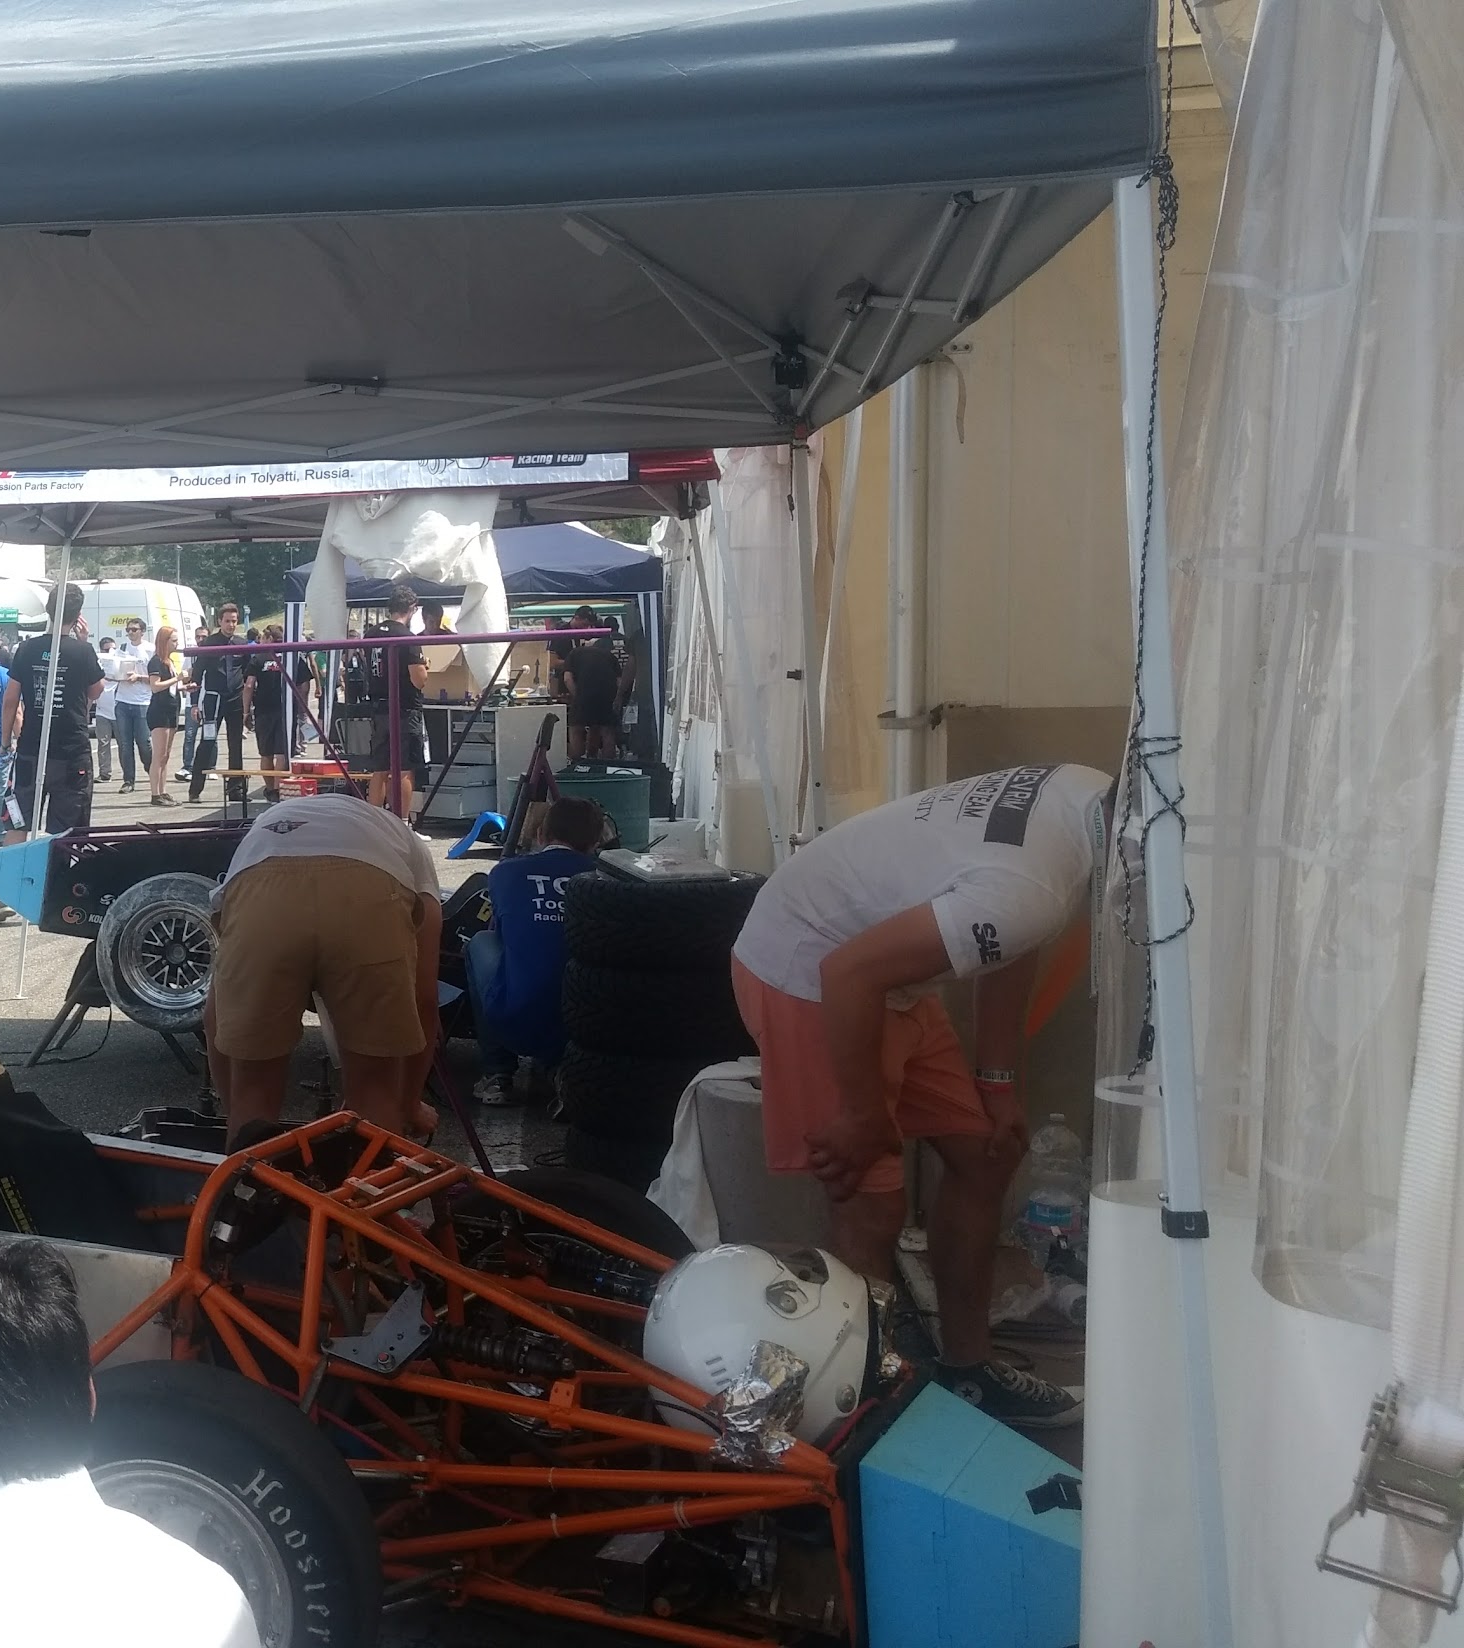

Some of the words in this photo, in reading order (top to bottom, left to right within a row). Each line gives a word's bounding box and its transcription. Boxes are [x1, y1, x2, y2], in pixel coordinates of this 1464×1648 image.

[517, 453, 554, 466] Racing
[556, 453, 584, 464] Team
[24, 482, 48, 491] Parts
[50, 481, 84, 491] Factory
[169, 473, 231, 487] Produced
[235, 473, 246, 484] in
[250, 472, 300, 486] Tolyatti,
[304, 468, 354, 480] Russia.
[111, 616, 134, 626] Hert
[963, 793, 994, 818] TEAM
[971, 922, 1002, 965] SAE
[232, 1468, 331, 1643] Hoosier
